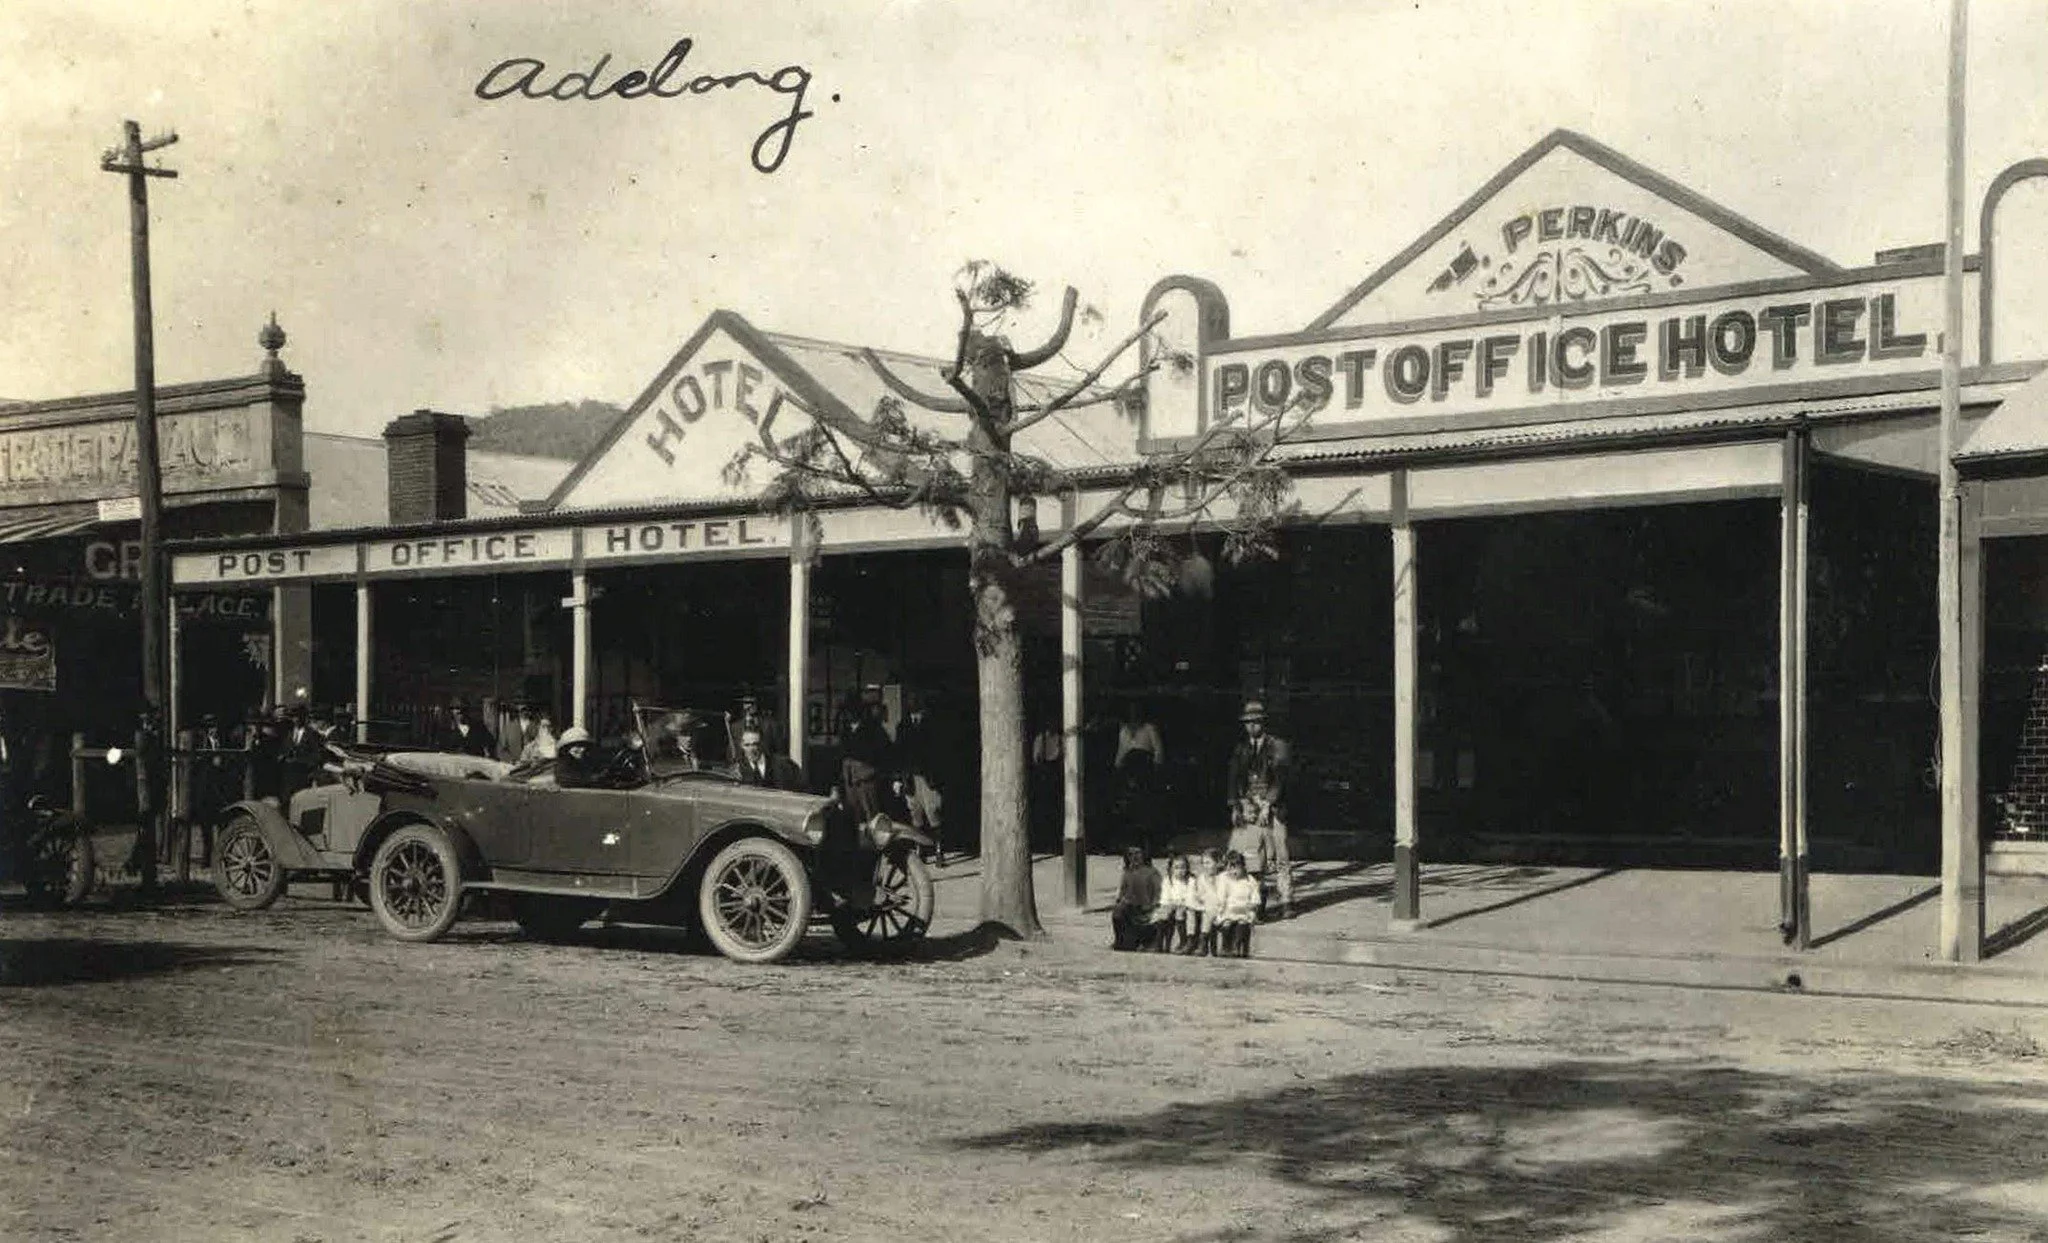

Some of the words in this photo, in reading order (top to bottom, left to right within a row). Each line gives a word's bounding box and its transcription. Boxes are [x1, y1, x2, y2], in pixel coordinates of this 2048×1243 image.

[1213, 349, 1378, 424] POST
[1382, 321, 1649, 407] OFFICE
[647, 360, 782, 466] HOTEL
[218, 550, 311, 578] POST
[391, 535, 536, 566] OFFICE
[3, 580, 116, 608] TRADE
